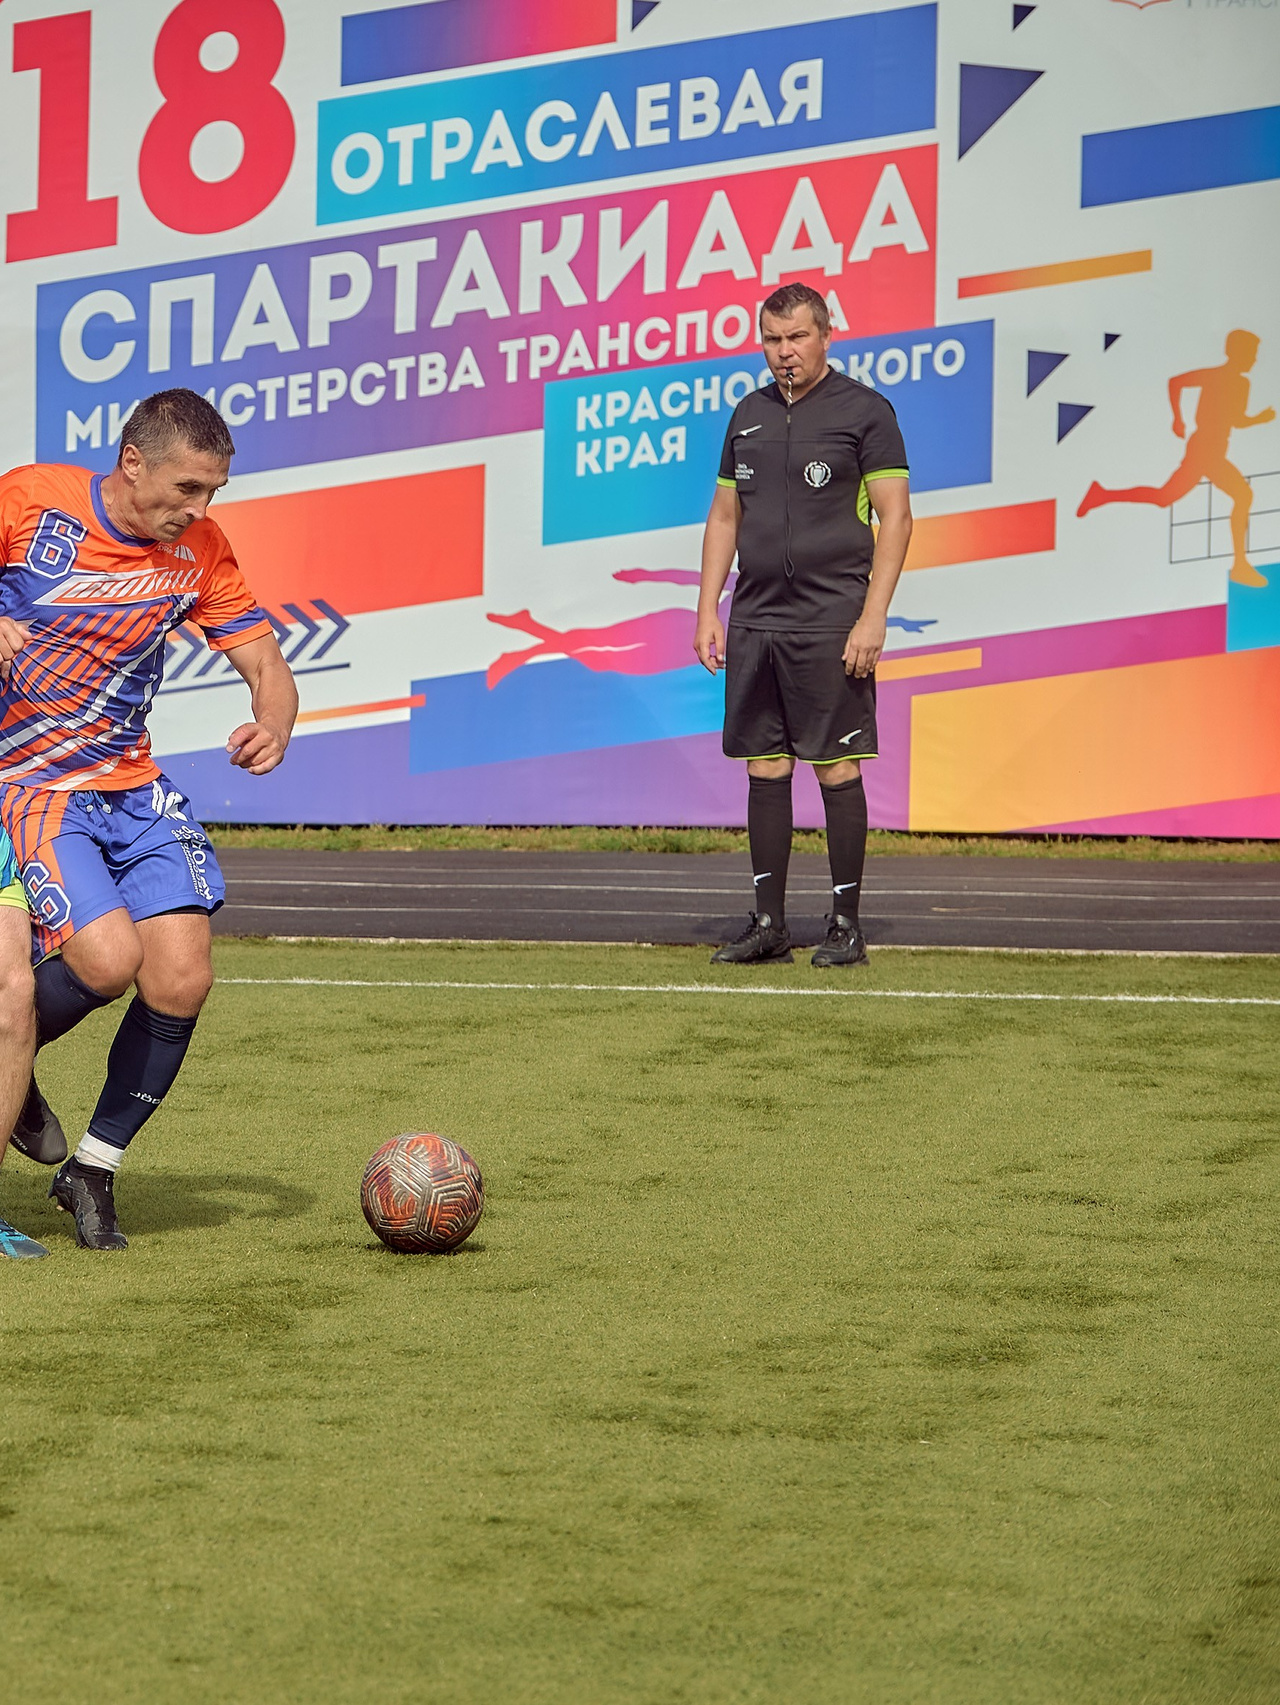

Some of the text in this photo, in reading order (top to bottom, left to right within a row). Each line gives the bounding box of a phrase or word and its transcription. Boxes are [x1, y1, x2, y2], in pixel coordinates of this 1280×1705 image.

[6, 0, 296, 263] 18
[331, 58, 823, 195] ОТРАСЛЕВАЯ
[59, 163, 929, 384] СПАРТАКИАДА
[65, 290, 850, 453] МИСТЕРСТВА ТРАНСПОА
[576, 339, 966, 433] КРАСНОКОГО
[576, 427, 687, 477] КРАЯ
[25, 508, 88, 580] 6
[21, 860, 72, 931] 6
